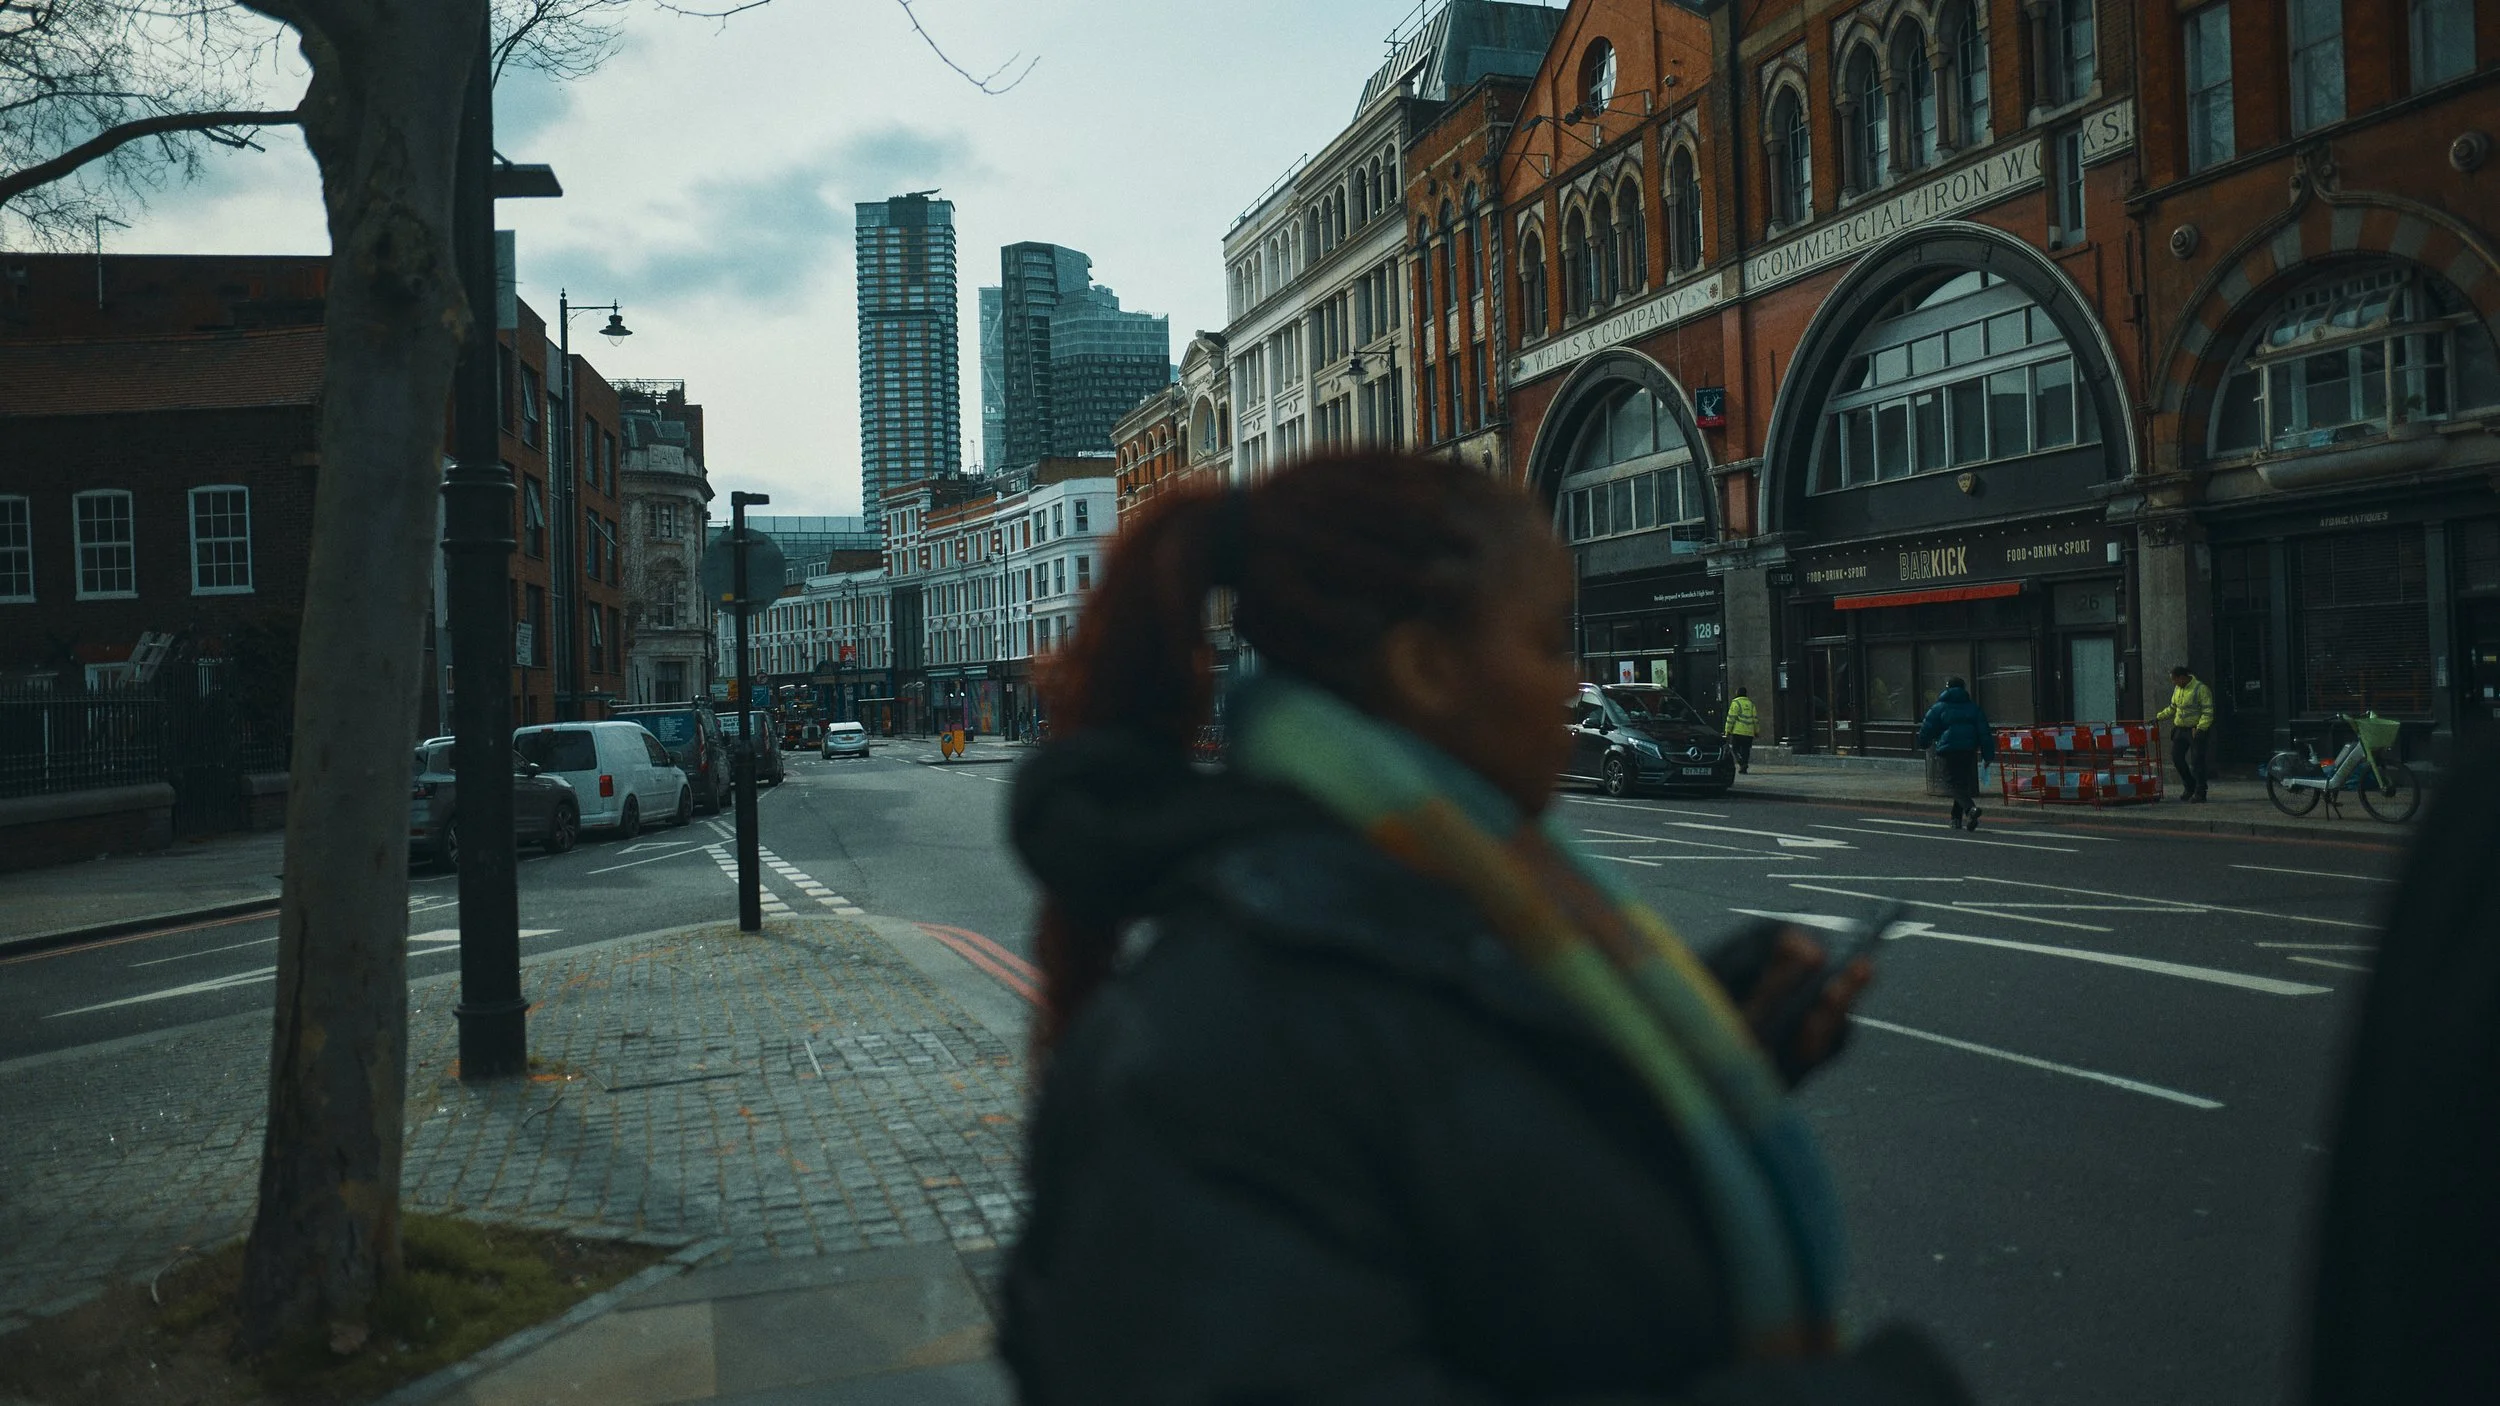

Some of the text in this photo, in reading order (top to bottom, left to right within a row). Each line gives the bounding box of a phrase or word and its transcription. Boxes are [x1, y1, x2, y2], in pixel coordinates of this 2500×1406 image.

[1756, 199, 1912, 282] COMMERCIAL
[1924, 164, 1989, 215] IRON
[1534, 292, 1684, 371] WELLS & COMPANY
[1899, 545, 1968, 581] BARKICK
[2006, 539, 2090, 562] FOOD DRINK SPORT
[1806, 566, 1867, 583] FOOD DRINK SPORT
[1694, 623, 1712, 639] 128
